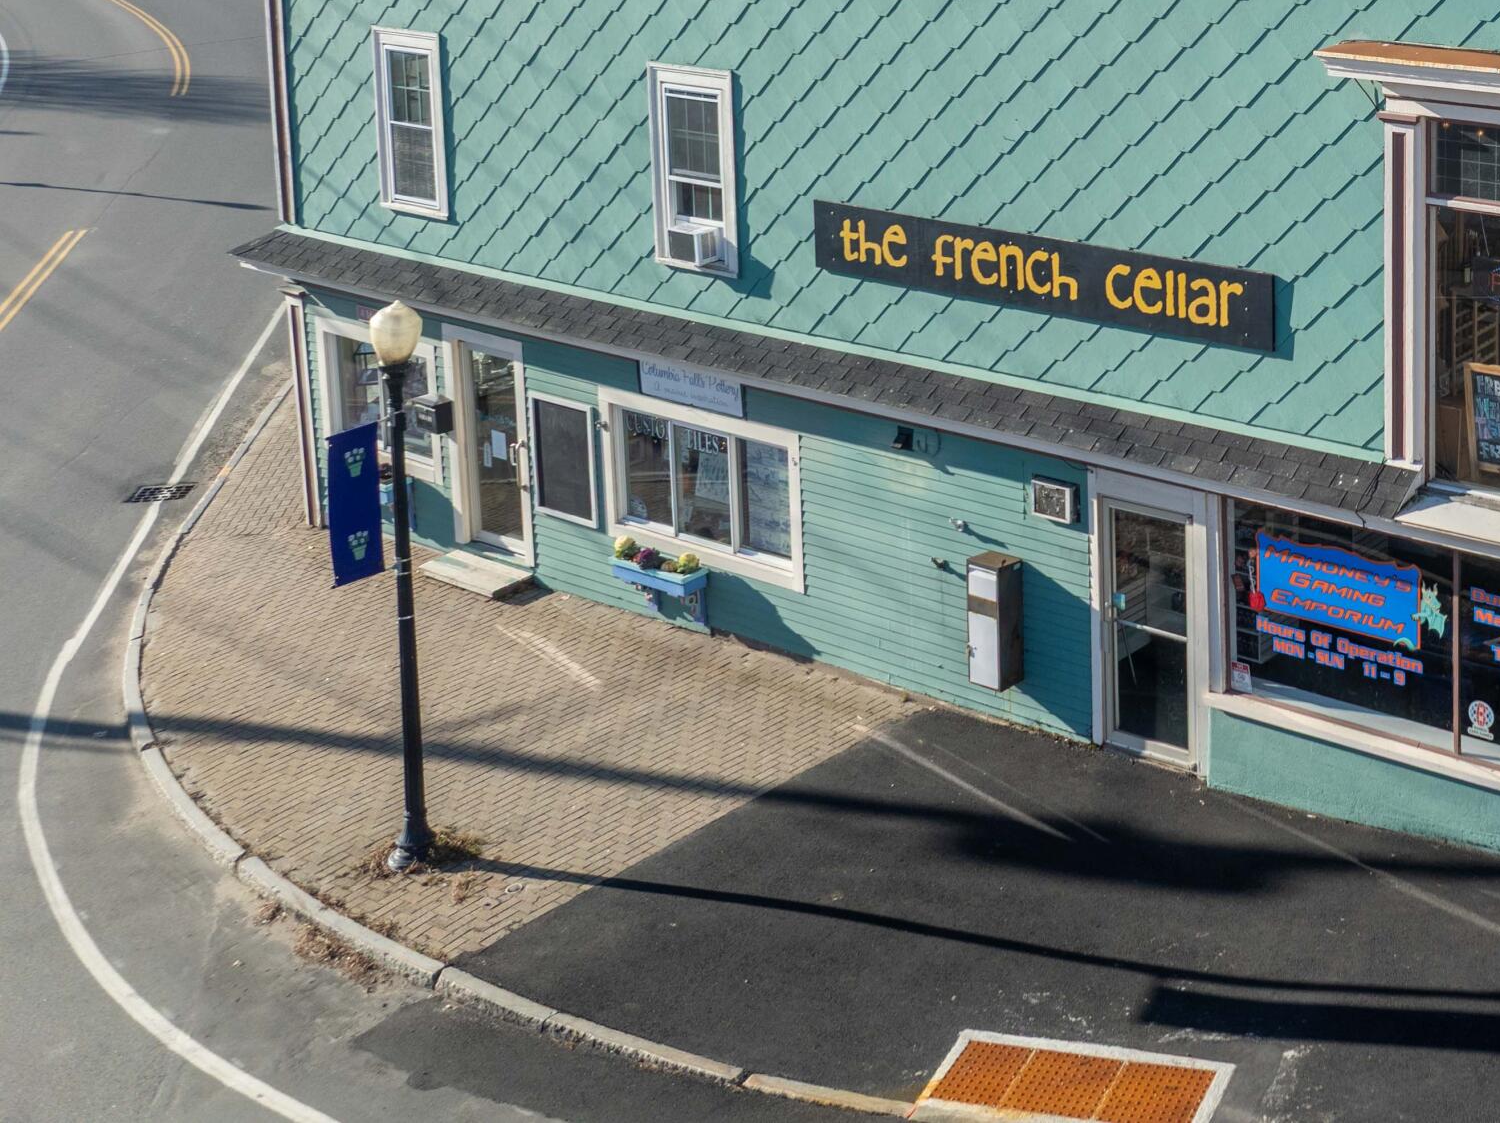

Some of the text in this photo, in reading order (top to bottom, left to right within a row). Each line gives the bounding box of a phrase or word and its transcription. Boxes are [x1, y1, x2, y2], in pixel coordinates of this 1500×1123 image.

[840, 219, 1243, 327] the french cellar
[687, 429, 720, 455] TILES
[1255, 615, 1306, 643] Hours
[1337, 635, 1424, 674] Operation
[1272, 637, 1305, 660] MON
[1315, 647, 1345, 670] SUN
[1363, 661, 1378, 679] 11
[1393, 669, 1406, 686] 9
